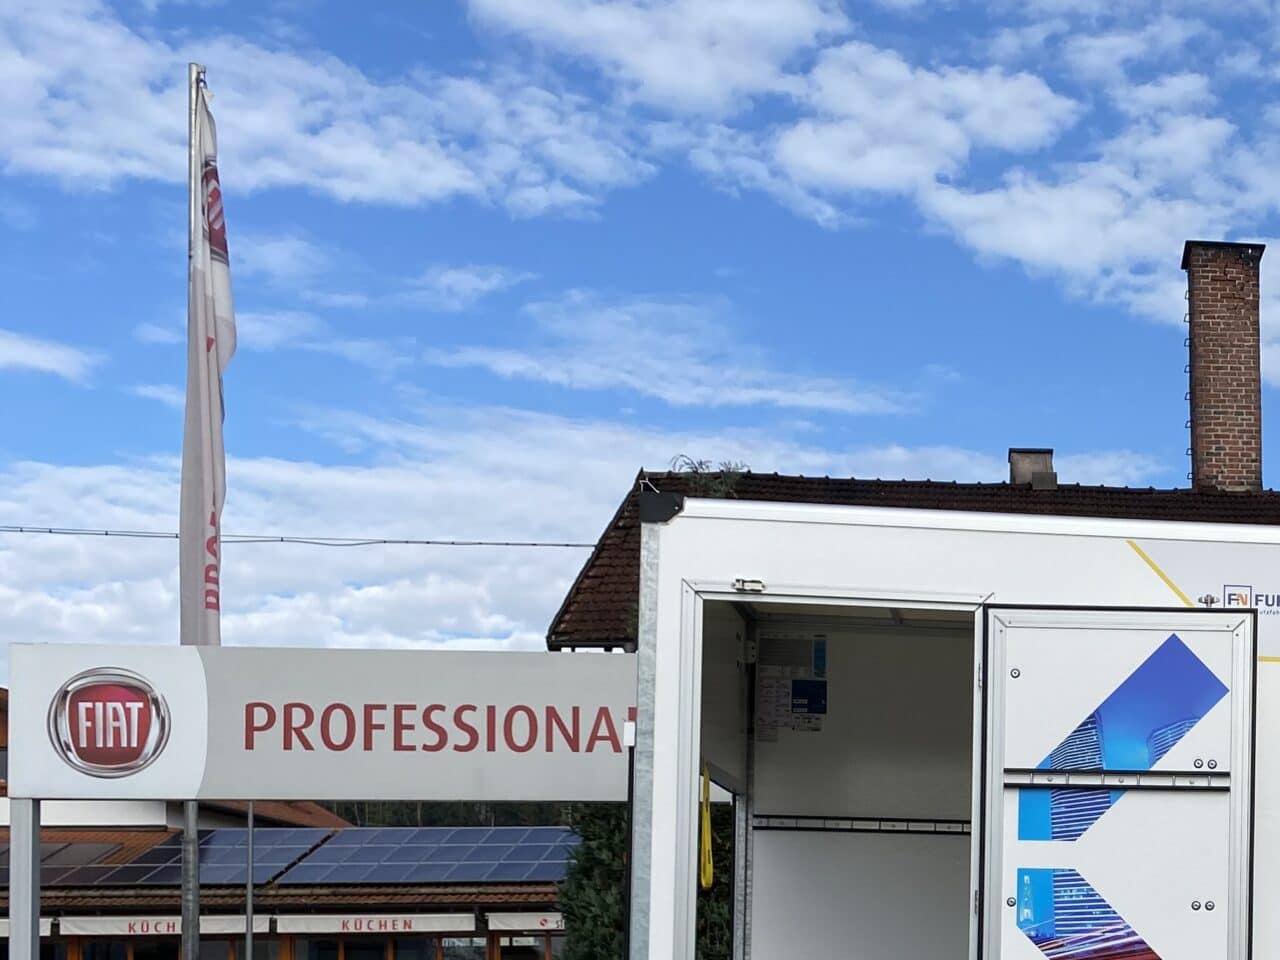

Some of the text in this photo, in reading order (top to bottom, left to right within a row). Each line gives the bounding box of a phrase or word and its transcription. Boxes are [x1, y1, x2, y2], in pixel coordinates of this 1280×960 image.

[77, 701, 144, 749] FIAT
[244, 701, 638, 753] PROFESSIONA
[127, 919, 177, 934] KÜCH
[341, 919, 413, 931] KÜCHEN
